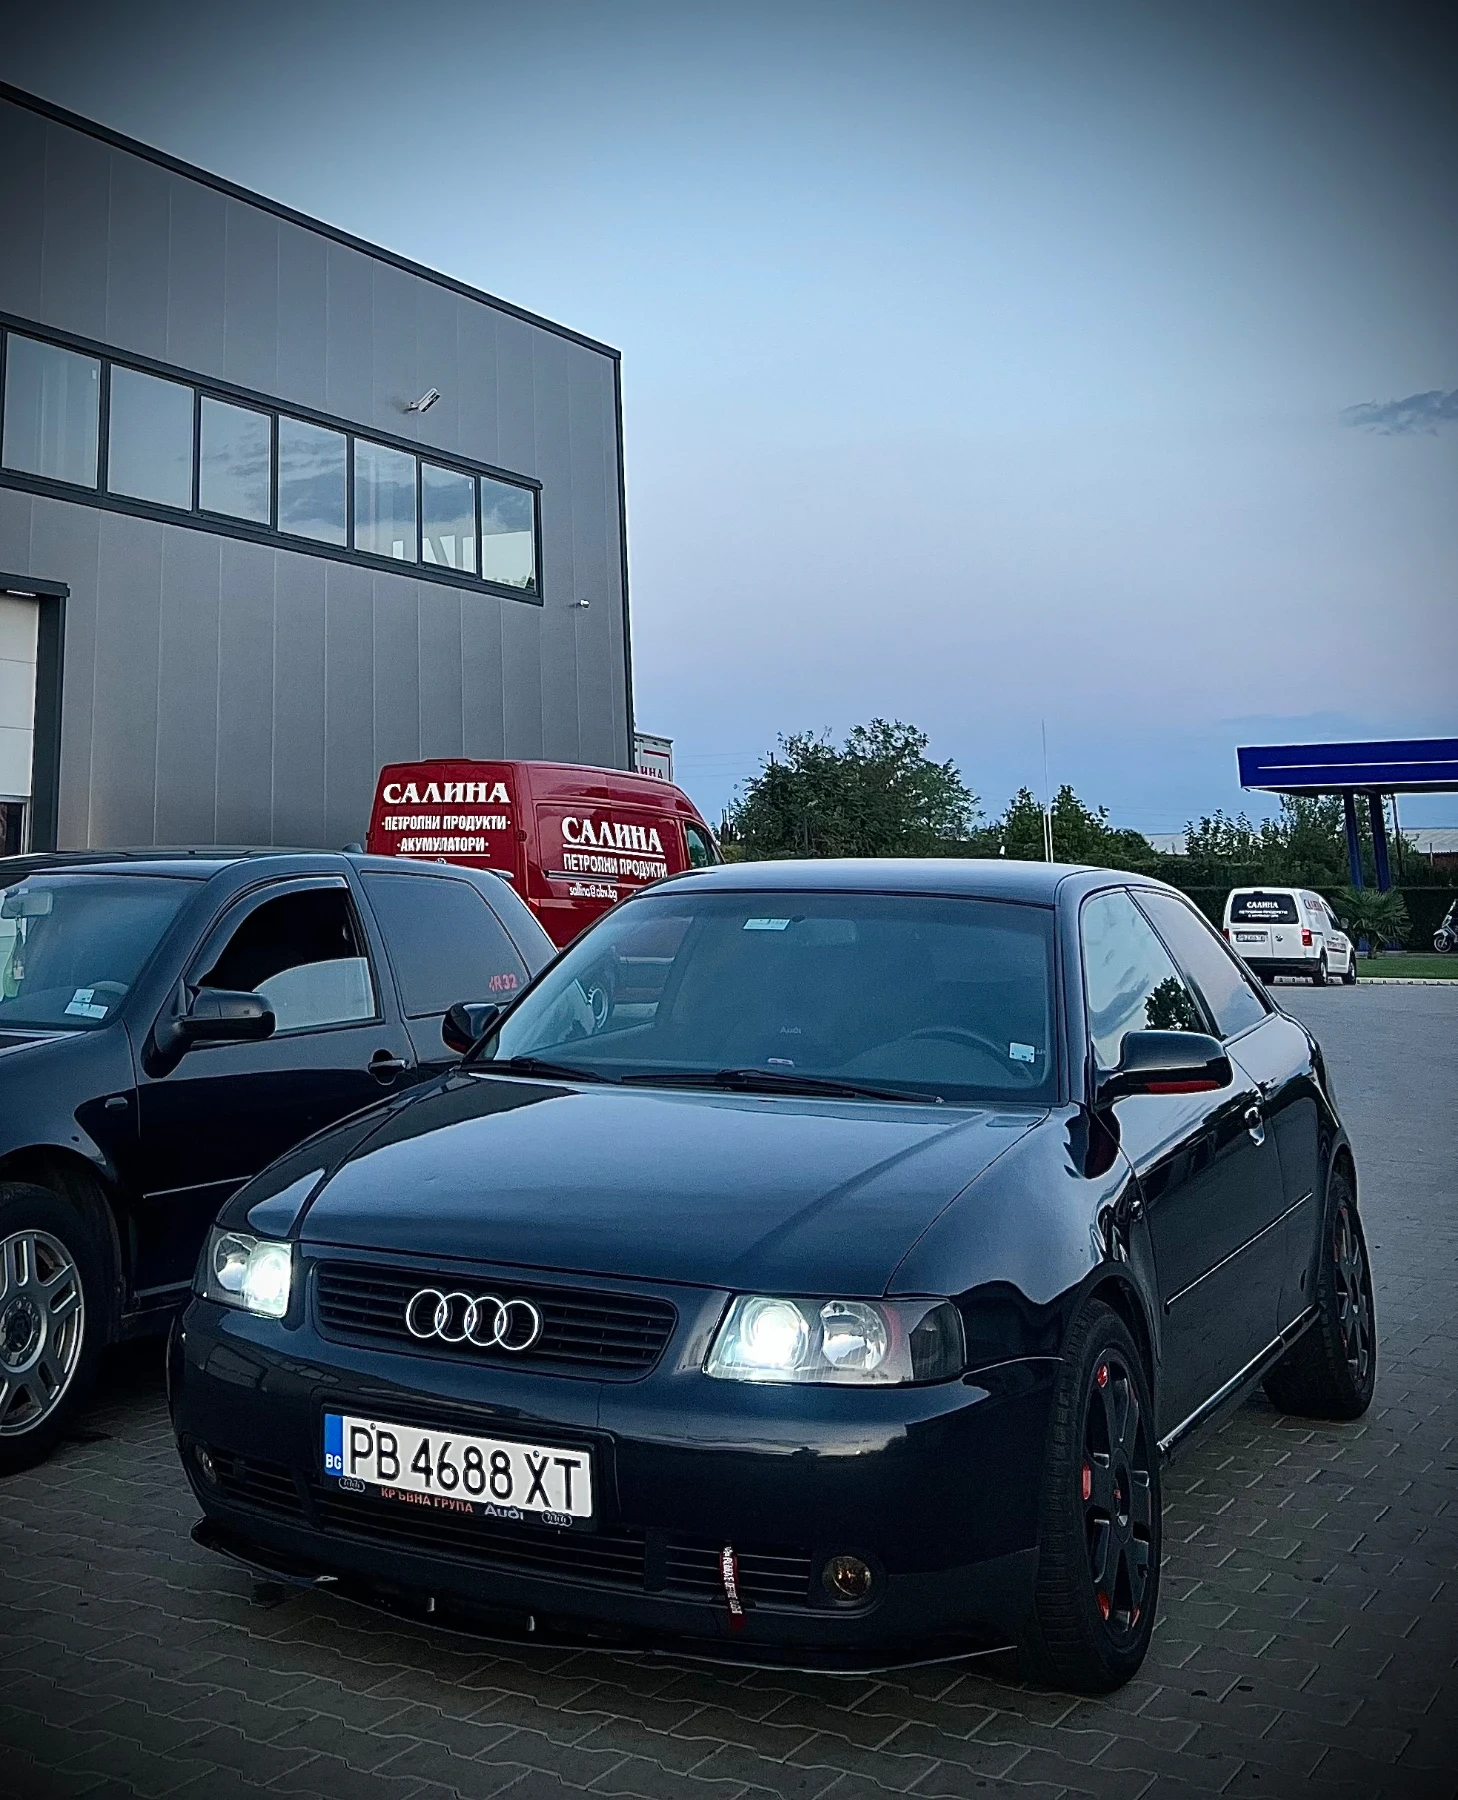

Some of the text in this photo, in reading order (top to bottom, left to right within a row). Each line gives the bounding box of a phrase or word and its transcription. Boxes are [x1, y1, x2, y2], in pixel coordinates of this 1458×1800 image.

[383, 782, 511, 803] САЛИНА
[562, 816, 664, 852] САЛИНА
[563, 853, 668, 880] ПЕТРОЛНИ ПРОДУКТИ
[325, 1453, 342, 1470] BG
[411, 1438, 513, 1500] 4688
[381, 1487, 474, 1513] КРЪВНА ГРУПА
[484, 1502, 524, 1521] Audi
